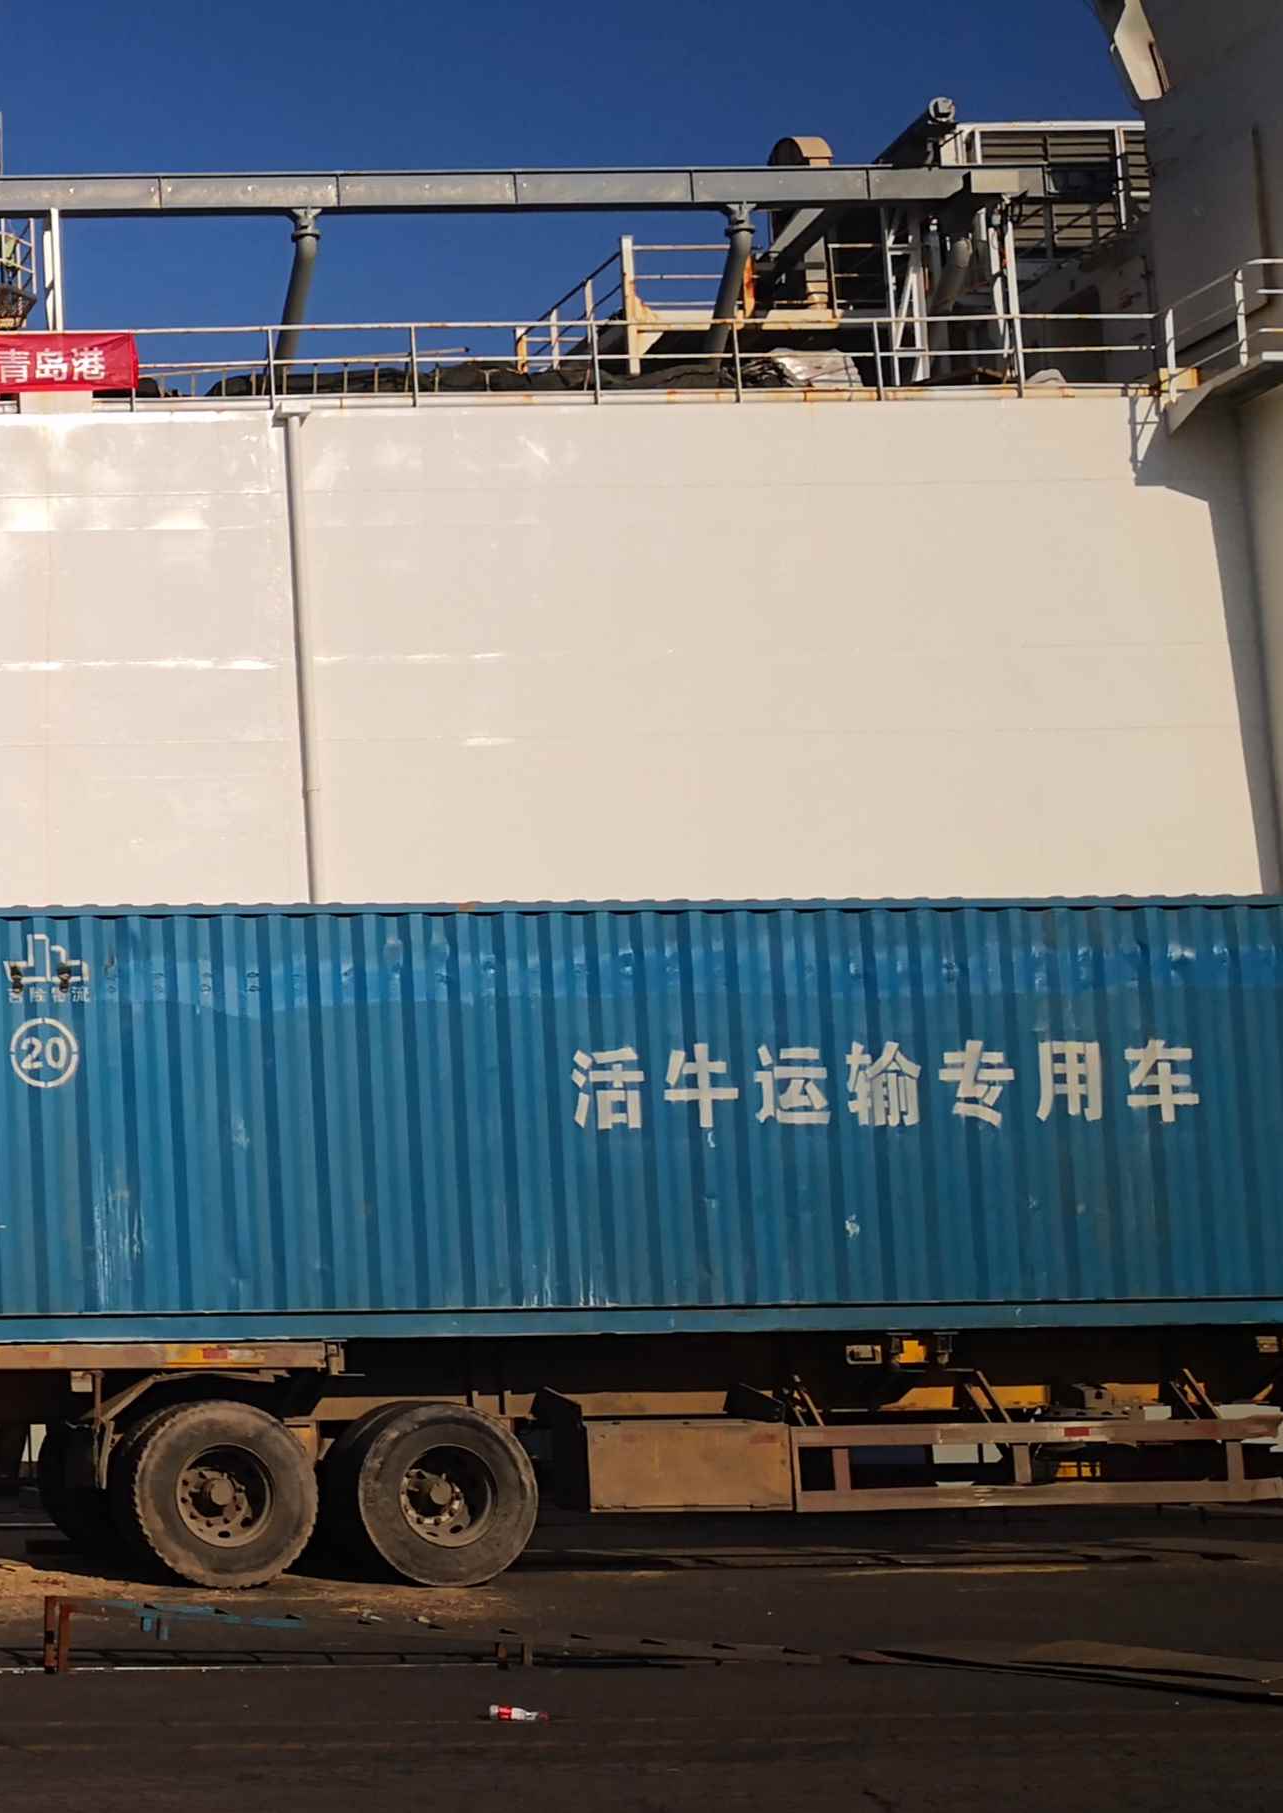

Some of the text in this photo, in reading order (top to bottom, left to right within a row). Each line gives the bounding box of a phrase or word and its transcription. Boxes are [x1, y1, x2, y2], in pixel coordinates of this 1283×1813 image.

[21, 1037, 68, 1069] 20
[572, 1039, 1200, 1130] 活牛运输专用车
